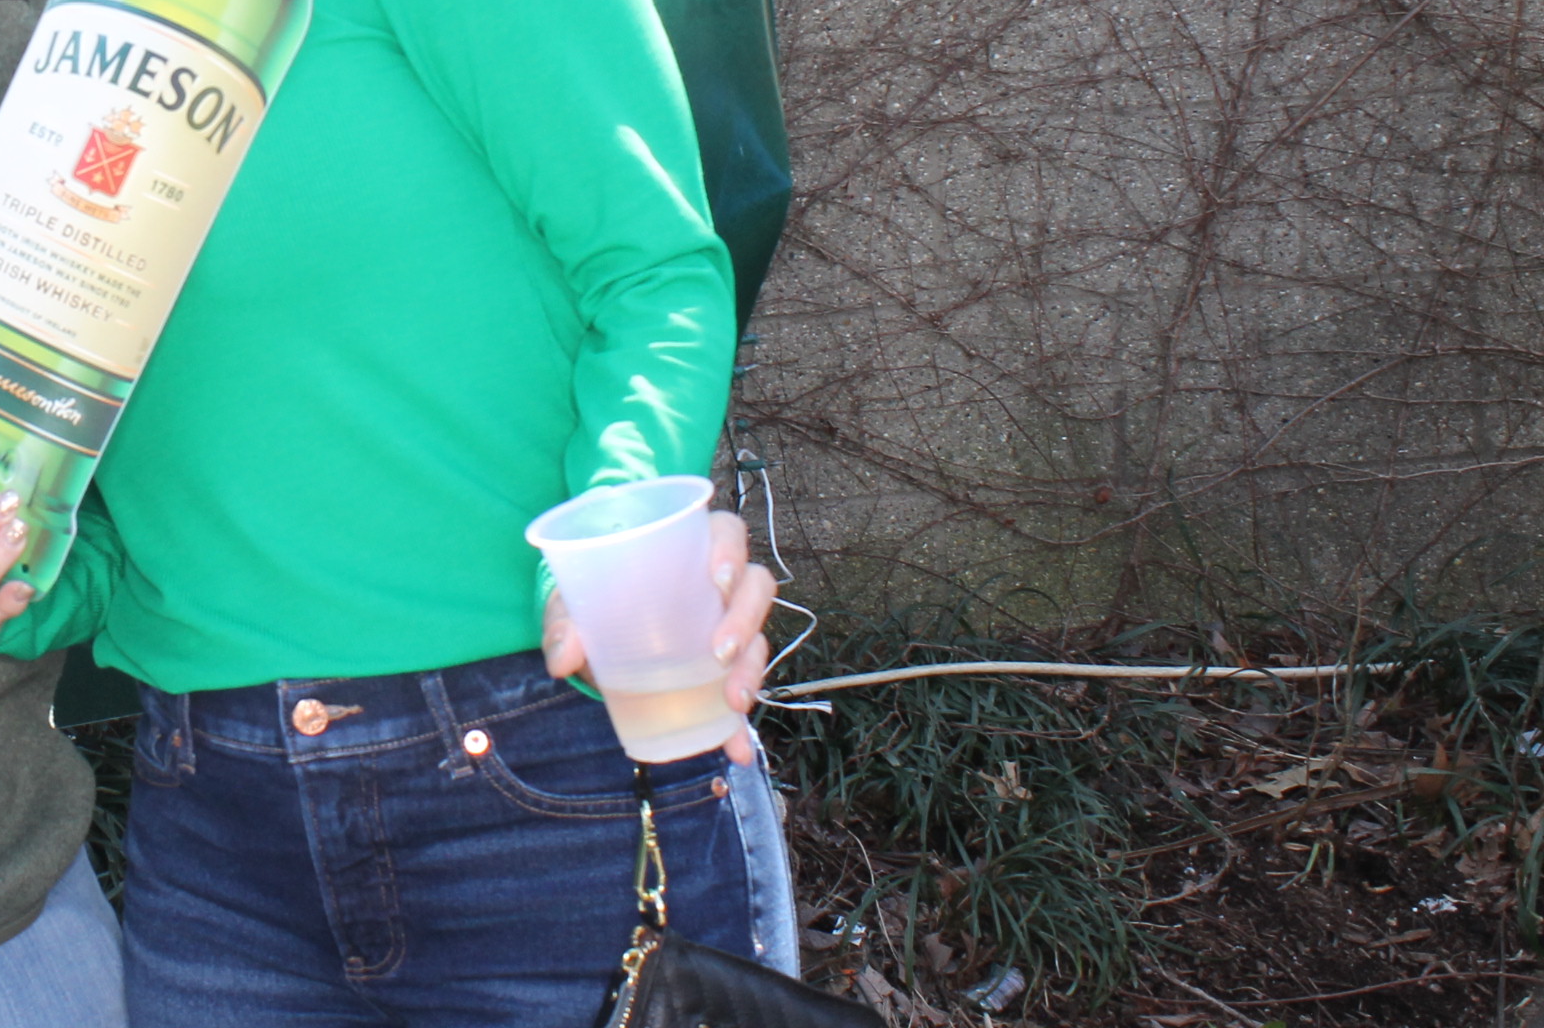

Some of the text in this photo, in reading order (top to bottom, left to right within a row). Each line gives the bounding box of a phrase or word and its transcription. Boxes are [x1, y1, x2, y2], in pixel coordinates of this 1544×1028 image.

[34, 31, 243, 154] JAMESON
[151, 179, 184, 202] 1780
[4, 194, 145, 271] TRIPLE DISTILLED
[5, 242, 55, 273] JAMESON
[53, 266, 78, 284] WAY
[77, 277, 110, 299] SINCE
[19, 233, 49, 254] IRISH
[47, 247, 97, 277] WHISKEY
[95, 270, 125, 291] MADE
[124, 283, 143, 299] THE
[36, 278, 110, 319] WHISKEY
